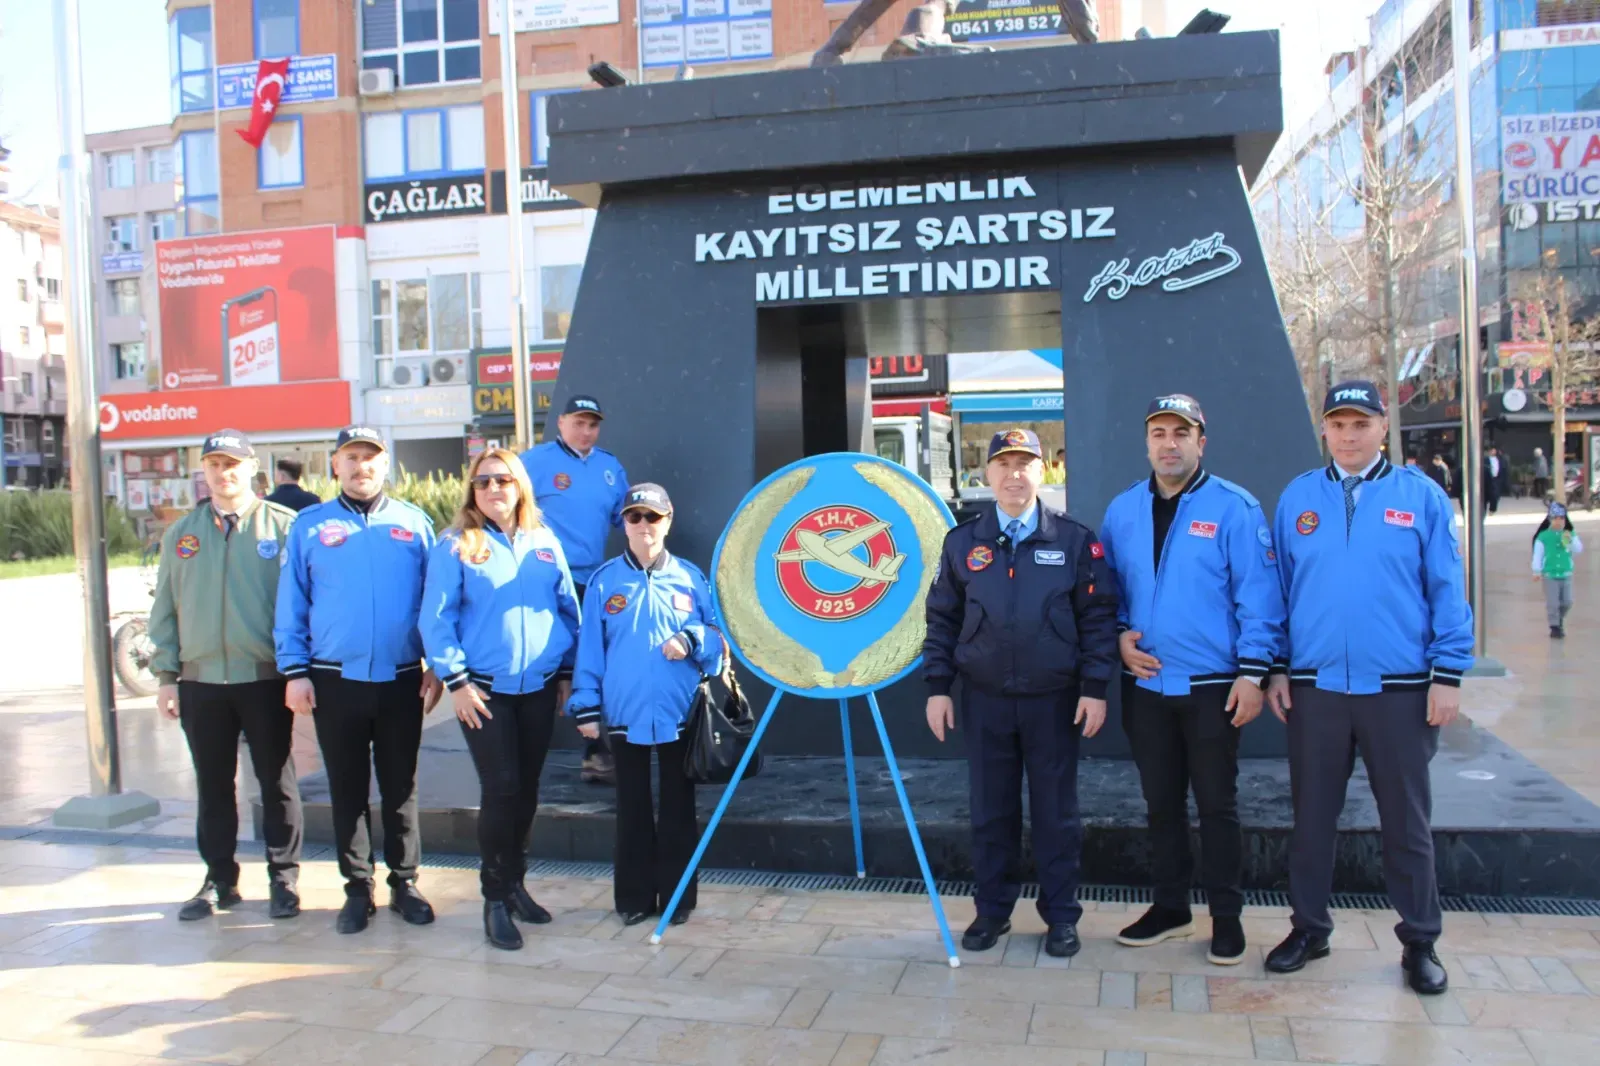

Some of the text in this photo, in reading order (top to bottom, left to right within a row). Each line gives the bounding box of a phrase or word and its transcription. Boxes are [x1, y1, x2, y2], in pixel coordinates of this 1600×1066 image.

[952, 20, 989, 36] 0541
[995, 18, 1024, 32] 938
[1028, 16, 1048, 29] 52
[1506, 118, 1534, 134] SİZ
[1544, 134, 1600, 169] YA
[1508, 172, 1600, 198] SÜRÜC
[368, 181, 485, 221] ÇAĞLAR
[695, 206, 1116, 261] KAYITSIZ ŞARTSIZ
[233, 340, 256, 367] 20
[1159, 398, 1191, 411] THK
[1334, 388, 1370, 402] THK
[122, 403, 198, 422] vodafone
[814, 598, 856, 614] 1925
